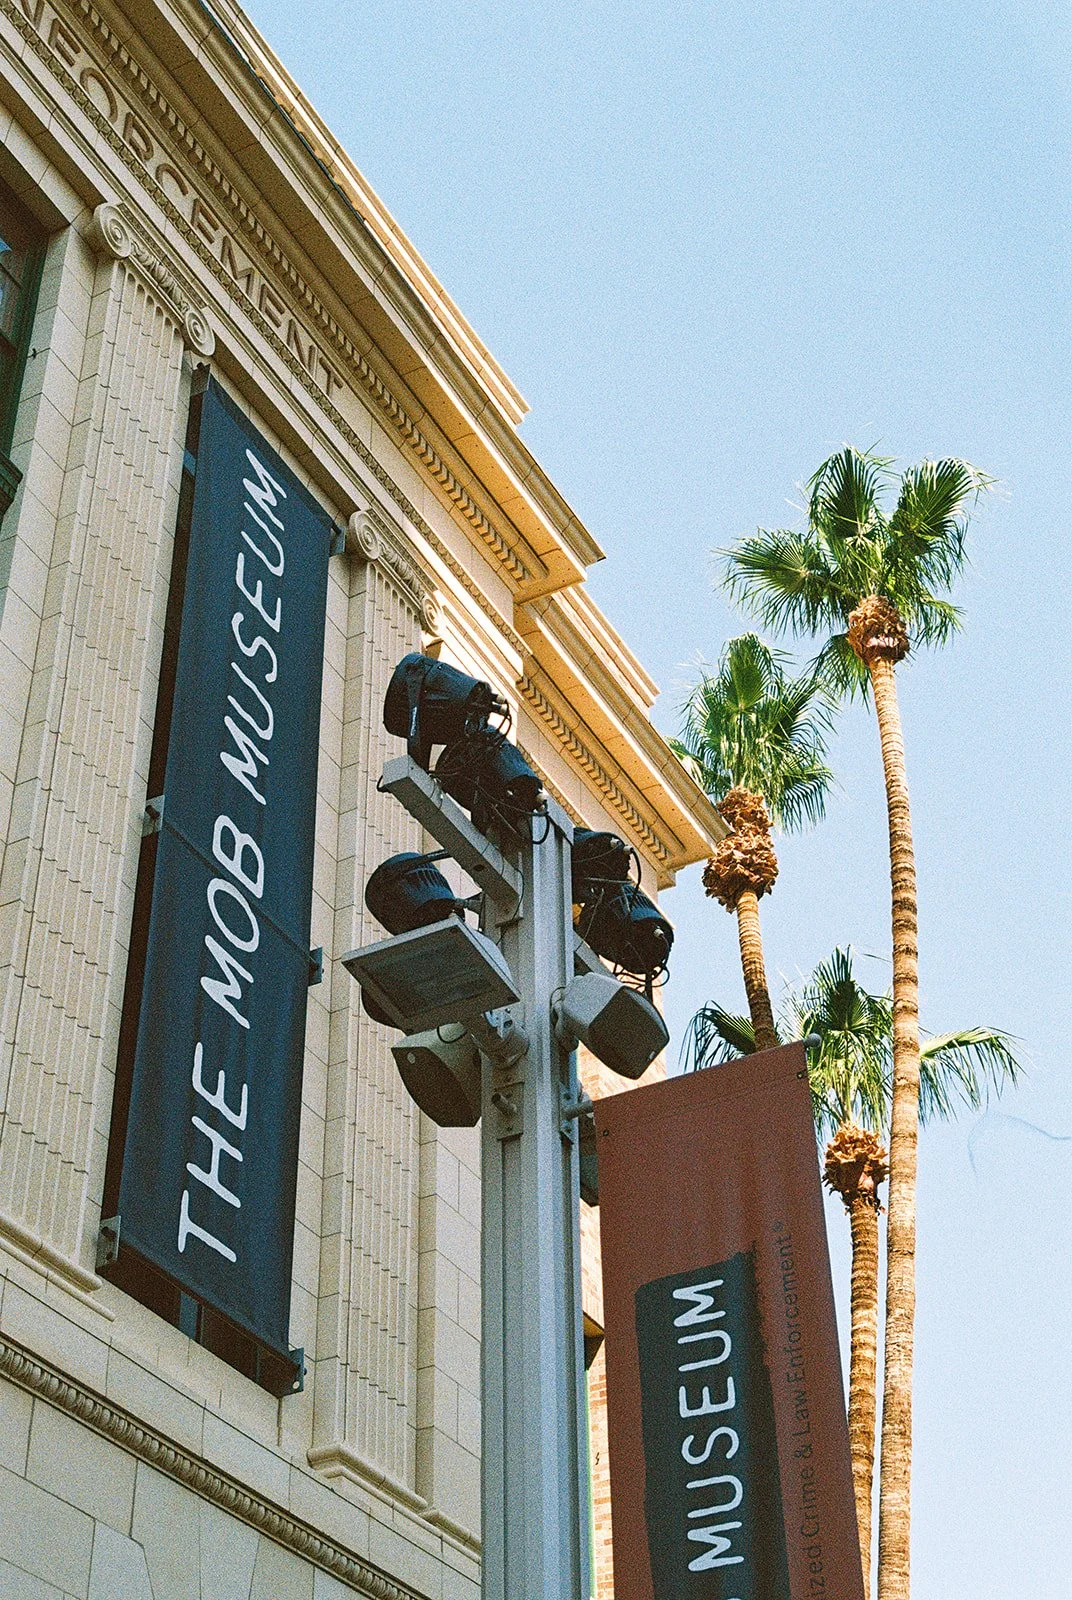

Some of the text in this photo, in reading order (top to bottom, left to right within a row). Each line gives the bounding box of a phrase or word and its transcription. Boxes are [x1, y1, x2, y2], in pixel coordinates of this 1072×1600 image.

[177, 448, 288, 1263] THE MOB MUSEUM
[672, 1279, 745, 1572] MUSEUM
[791, 1389, 811, 1436] Law
[793, 1443, 814, 1459] &
[799, 1464, 820, 1537] Crime
